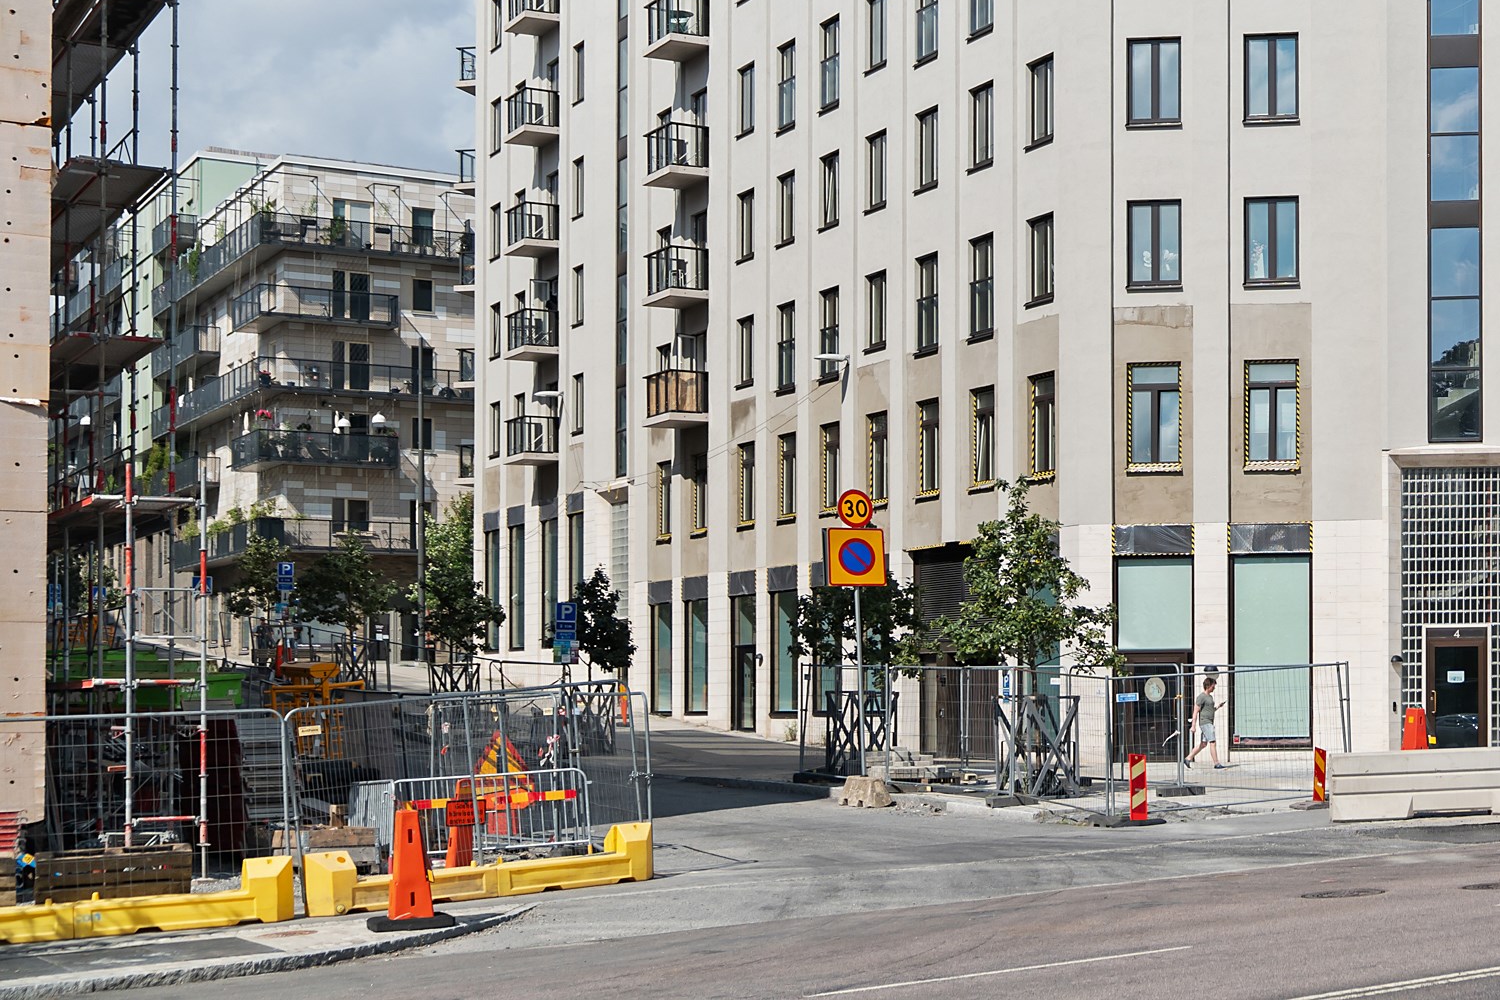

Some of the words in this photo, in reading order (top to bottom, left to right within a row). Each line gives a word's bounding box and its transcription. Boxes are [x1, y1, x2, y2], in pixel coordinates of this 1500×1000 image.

[843, 499, 868, 518] 30
[282, 564, 291, 575] P
[561, 604, 573, 620] P
[1453, 629, 1460, 638] 4
[1003, 675, 1009, 687] P
